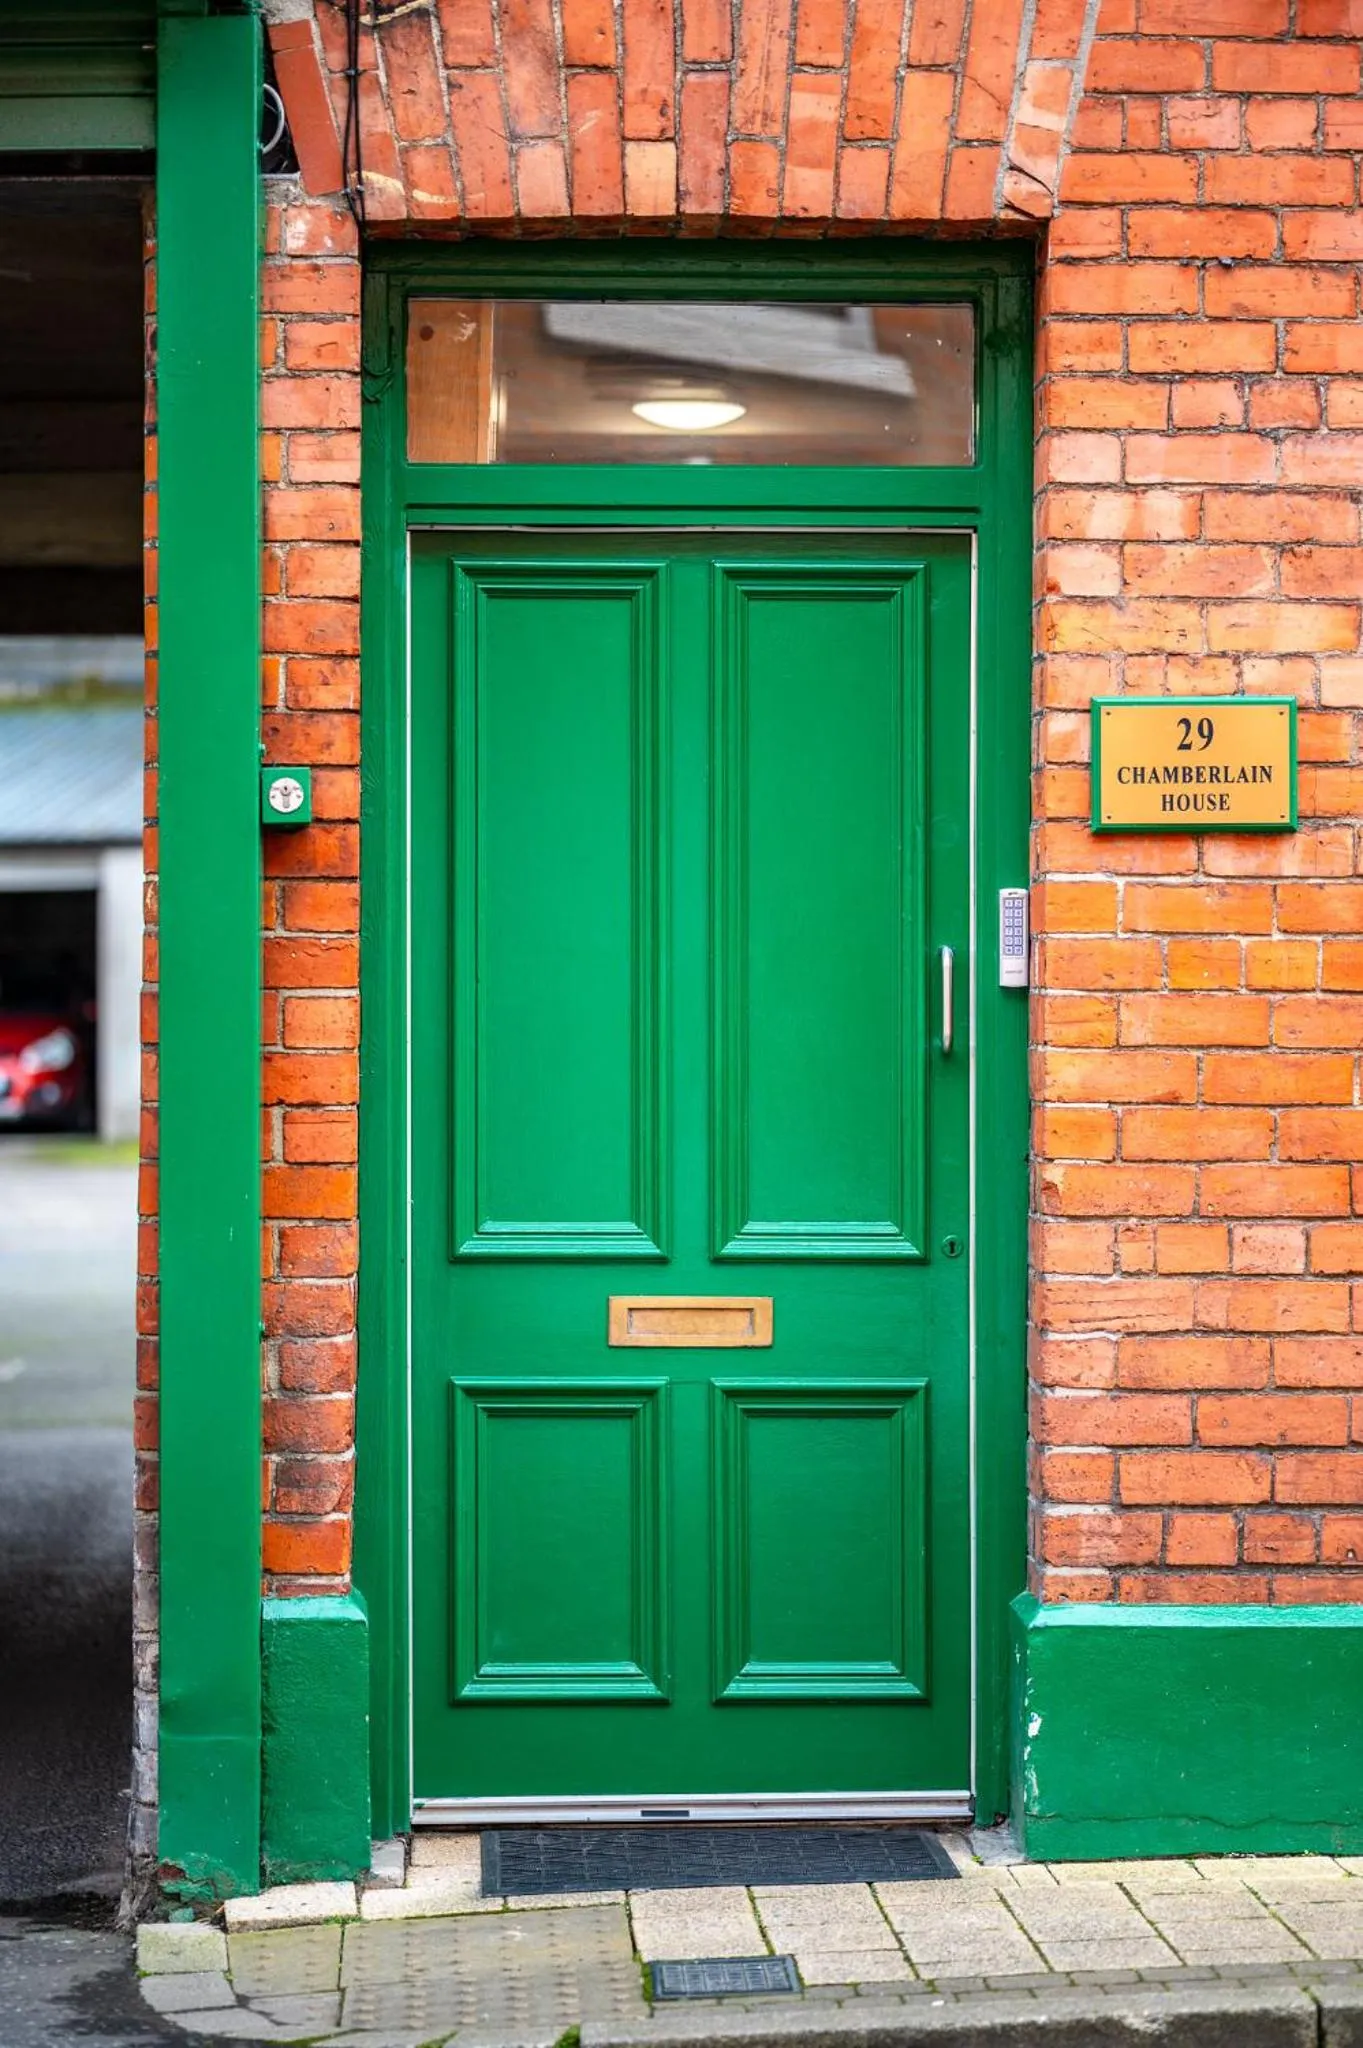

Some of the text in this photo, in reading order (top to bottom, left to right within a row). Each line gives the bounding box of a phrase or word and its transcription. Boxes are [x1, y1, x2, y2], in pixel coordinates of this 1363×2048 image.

[1177, 717, 1215, 752] 29
[1116, 765, 1273, 784] CHAMBERLAIN
[1161, 793, 1230, 812] HOUSE
